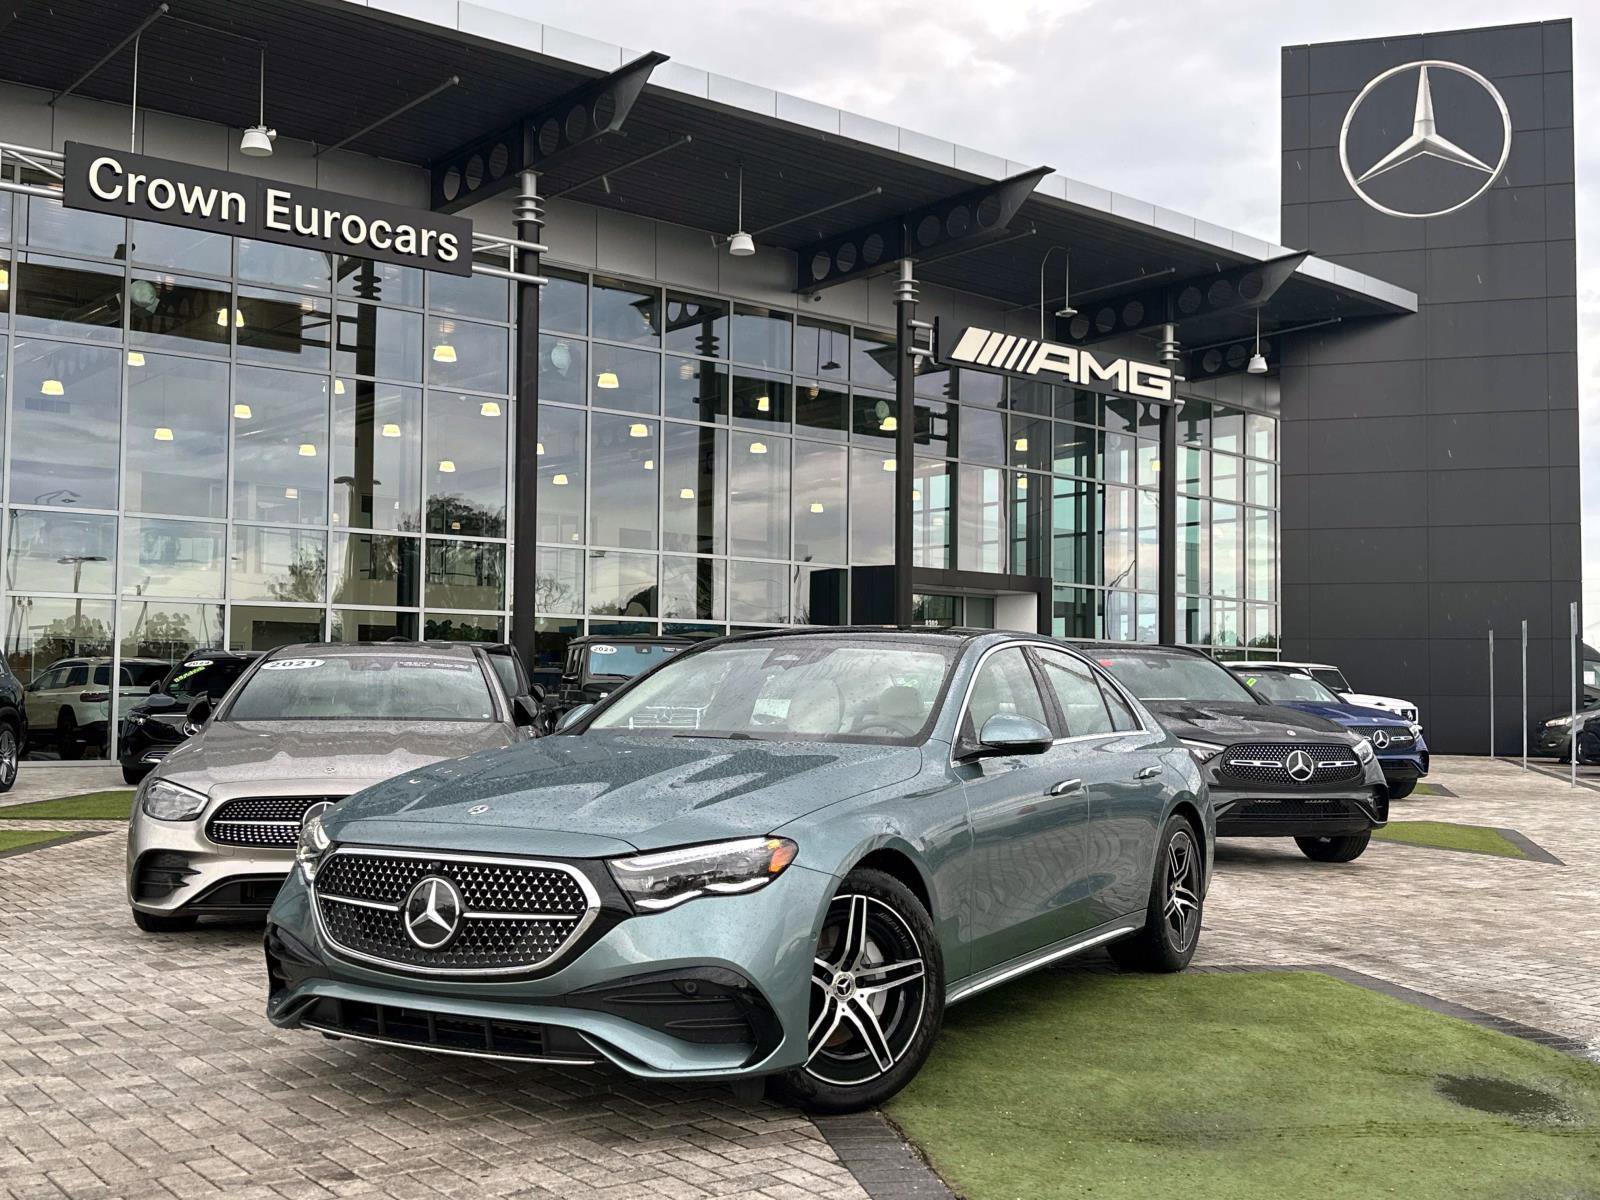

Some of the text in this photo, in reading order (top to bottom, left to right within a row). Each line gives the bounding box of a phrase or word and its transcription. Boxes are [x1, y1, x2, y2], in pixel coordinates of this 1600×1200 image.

[88, 157, 459, 263] Crown Eurocars
[1026, 342, 1171, 400] AMG
[269, 660, 317, 668] 2021
